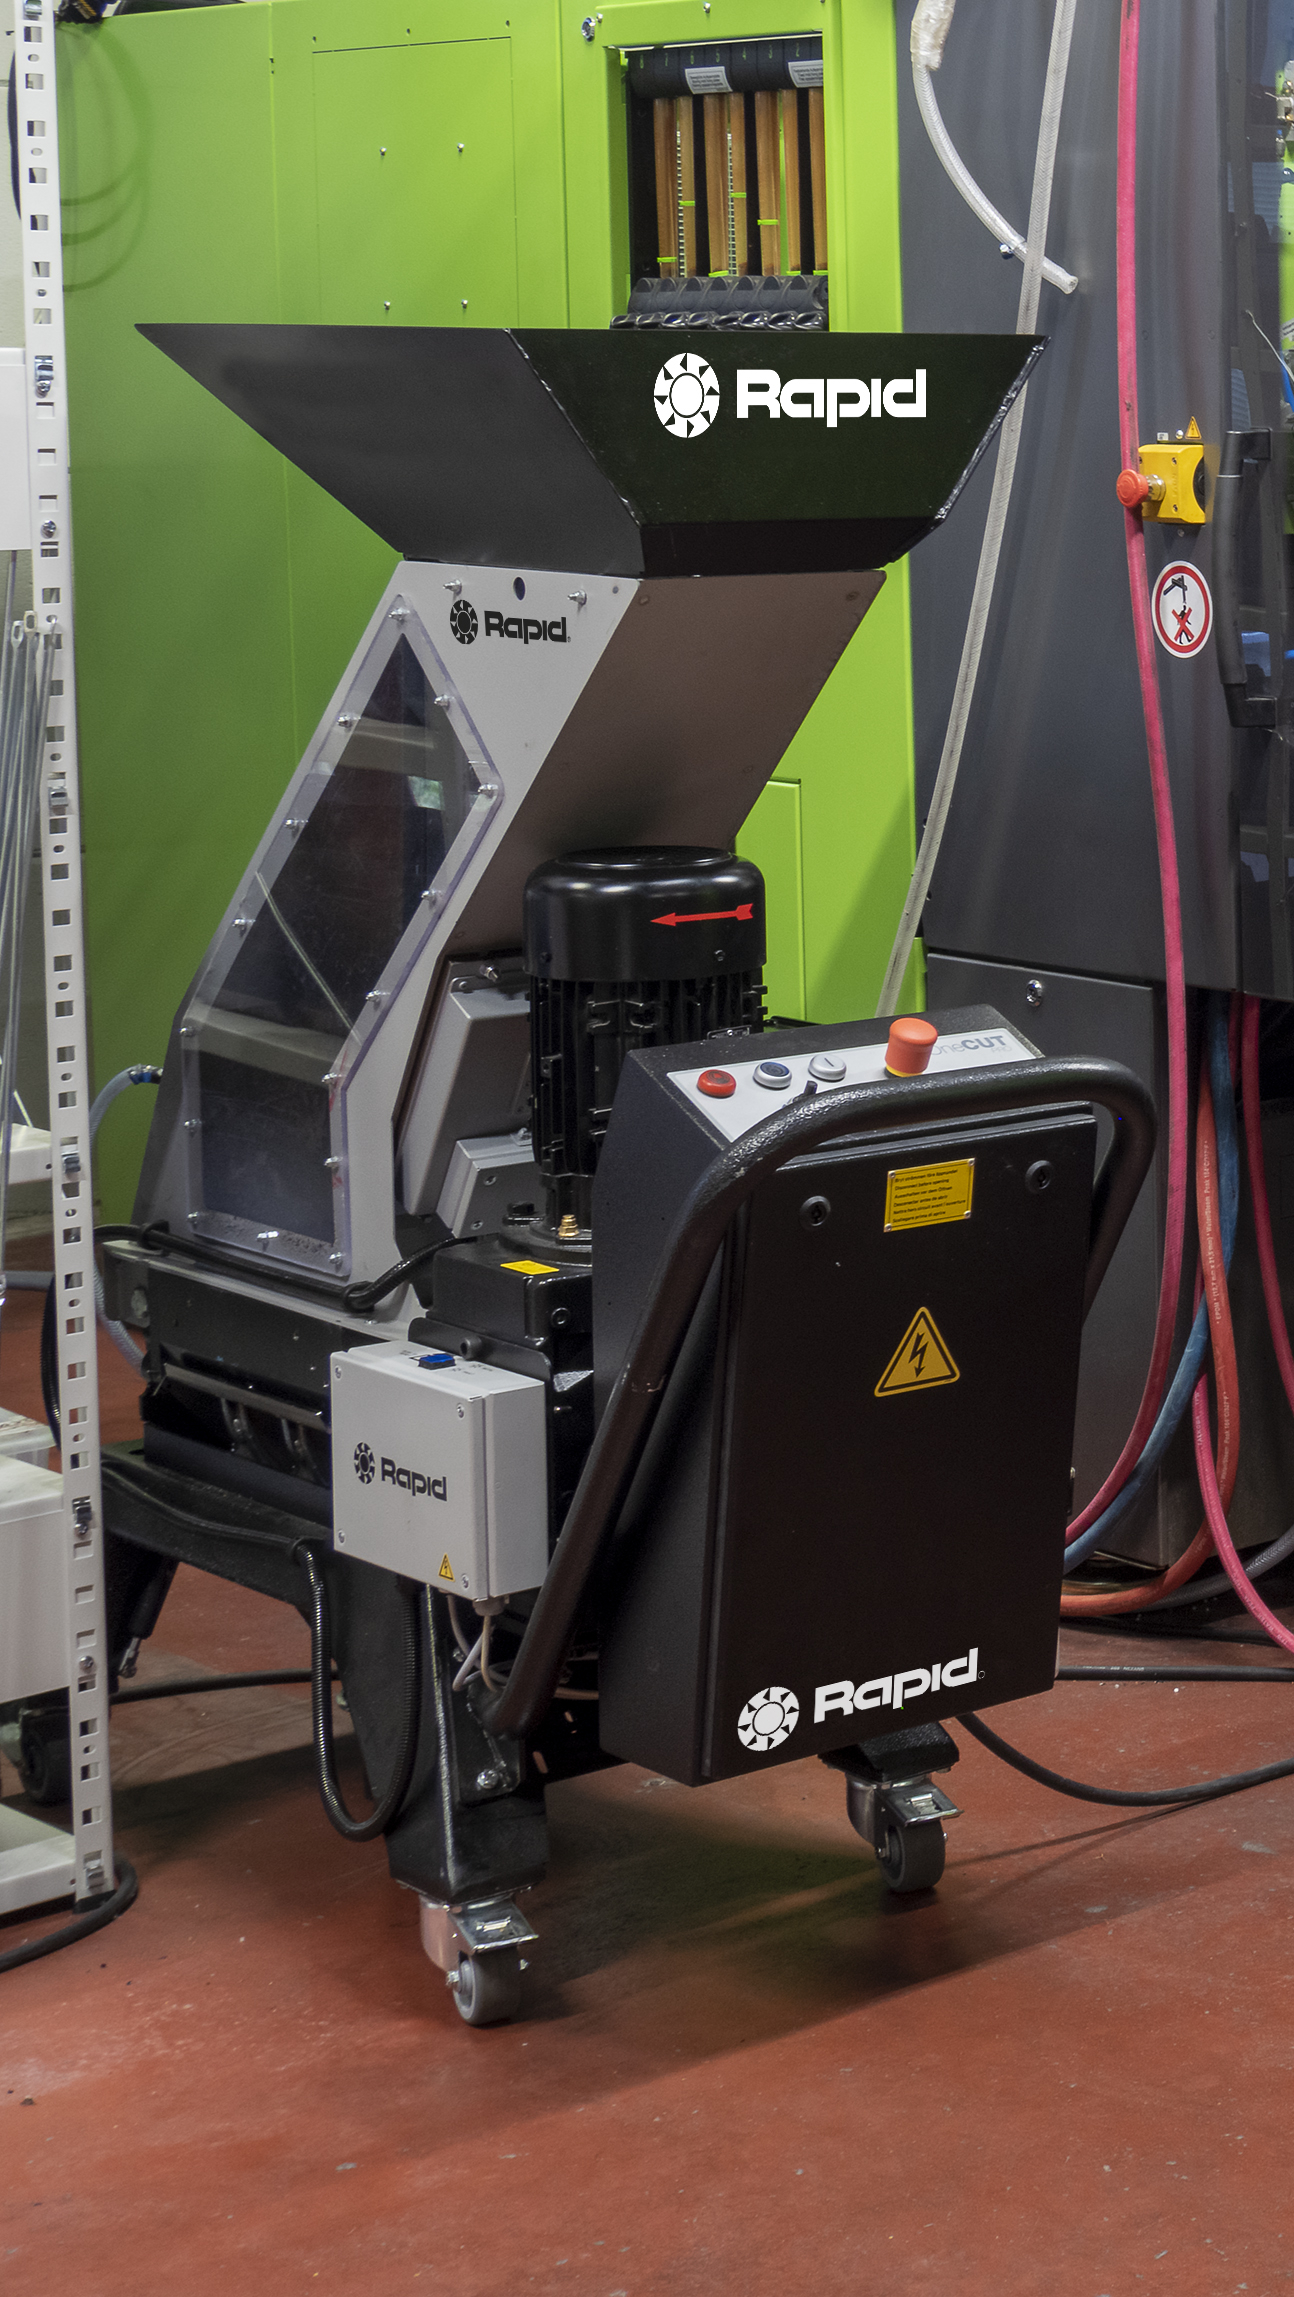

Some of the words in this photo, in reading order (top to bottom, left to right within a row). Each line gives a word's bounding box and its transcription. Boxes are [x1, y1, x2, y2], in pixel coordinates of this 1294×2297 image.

[737, 369, 926, 427] Rapid
[484, 611, 568, 645] Rapid
[381, 1457, 447, 1501] Rapid
[814, 1648, 978, 1723] Rapid
